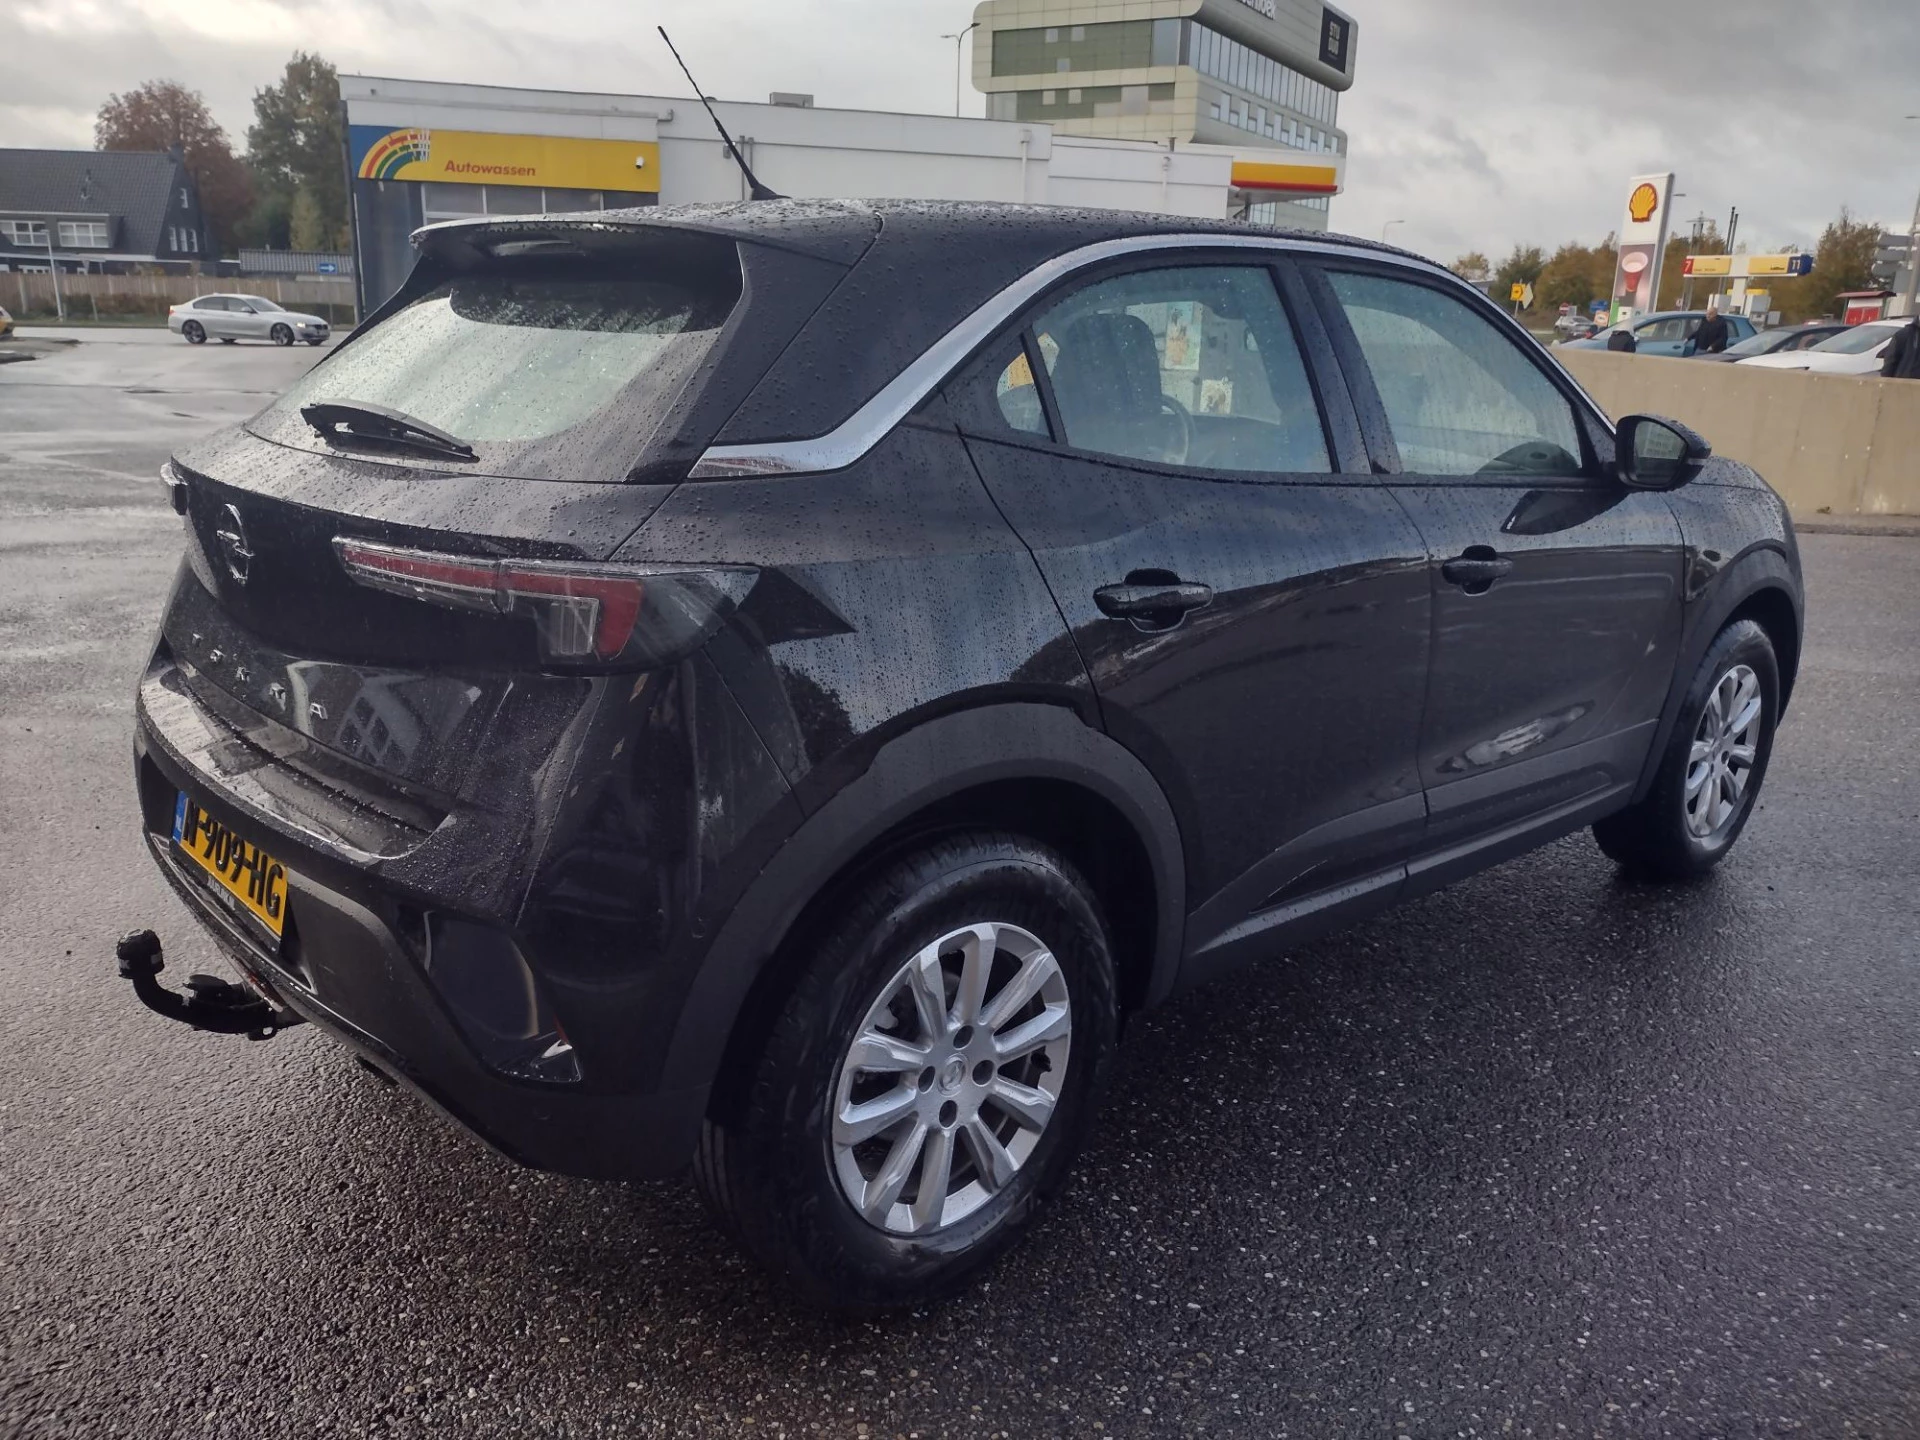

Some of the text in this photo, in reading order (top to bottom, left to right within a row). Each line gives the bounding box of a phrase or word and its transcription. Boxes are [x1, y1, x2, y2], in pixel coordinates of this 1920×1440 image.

[444, 160, 536, 176] Autowassen
[1684, 261, 1692, 272] 7
[1791, 259, 1801, 270] 11
[182, 797, 283, 919] N-909-HG
